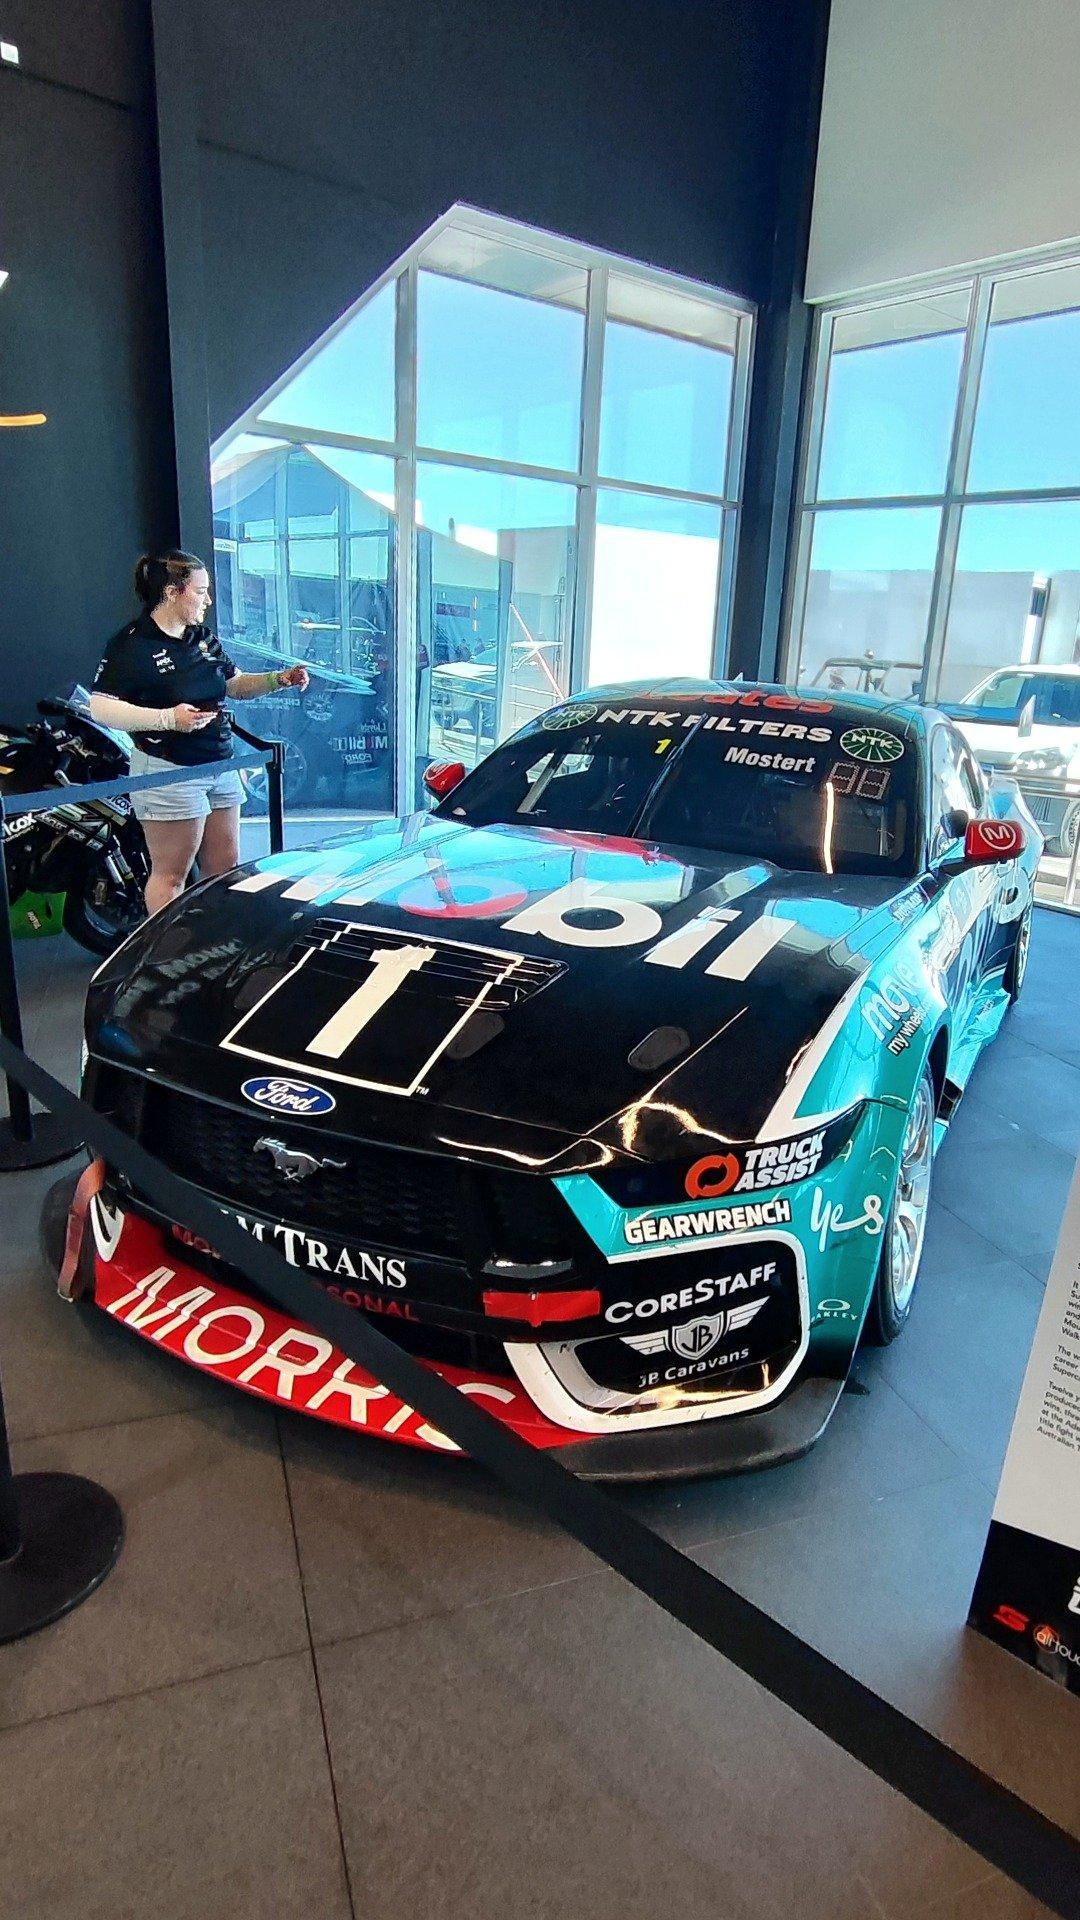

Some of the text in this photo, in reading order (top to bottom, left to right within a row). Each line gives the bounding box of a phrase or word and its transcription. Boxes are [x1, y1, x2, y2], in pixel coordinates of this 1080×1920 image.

[596, 709, 834, 742] NTK FILTERS
[654, 739, 672, 754] 1
[850, 734, 895, 750] NTK
[724, 746, 816, 773] Mostert
[305, 943, 437, 1059] 1
[887, 1033, 910, 1055] my
[254, 1081, 320, 1112] Ford
[745, 1130, 826, 1171] TRUCK
[733, 1153, 822, 1193] ASSIST
[624, 1200, 791, 1245] GEARWRENCH
[273, 1224, 408, 1289] TRANS
[1054, 1356, 1079, 1370] career
[1057, 1345, 1072, 1357] The
[638, 1348, 749, 1388] JB Caravans
[1048, 1380, 1074, 1398] Twelve
[1051, 1412, 1064, 1424] the
[1036, 1426, 1075, 1450] Australian
